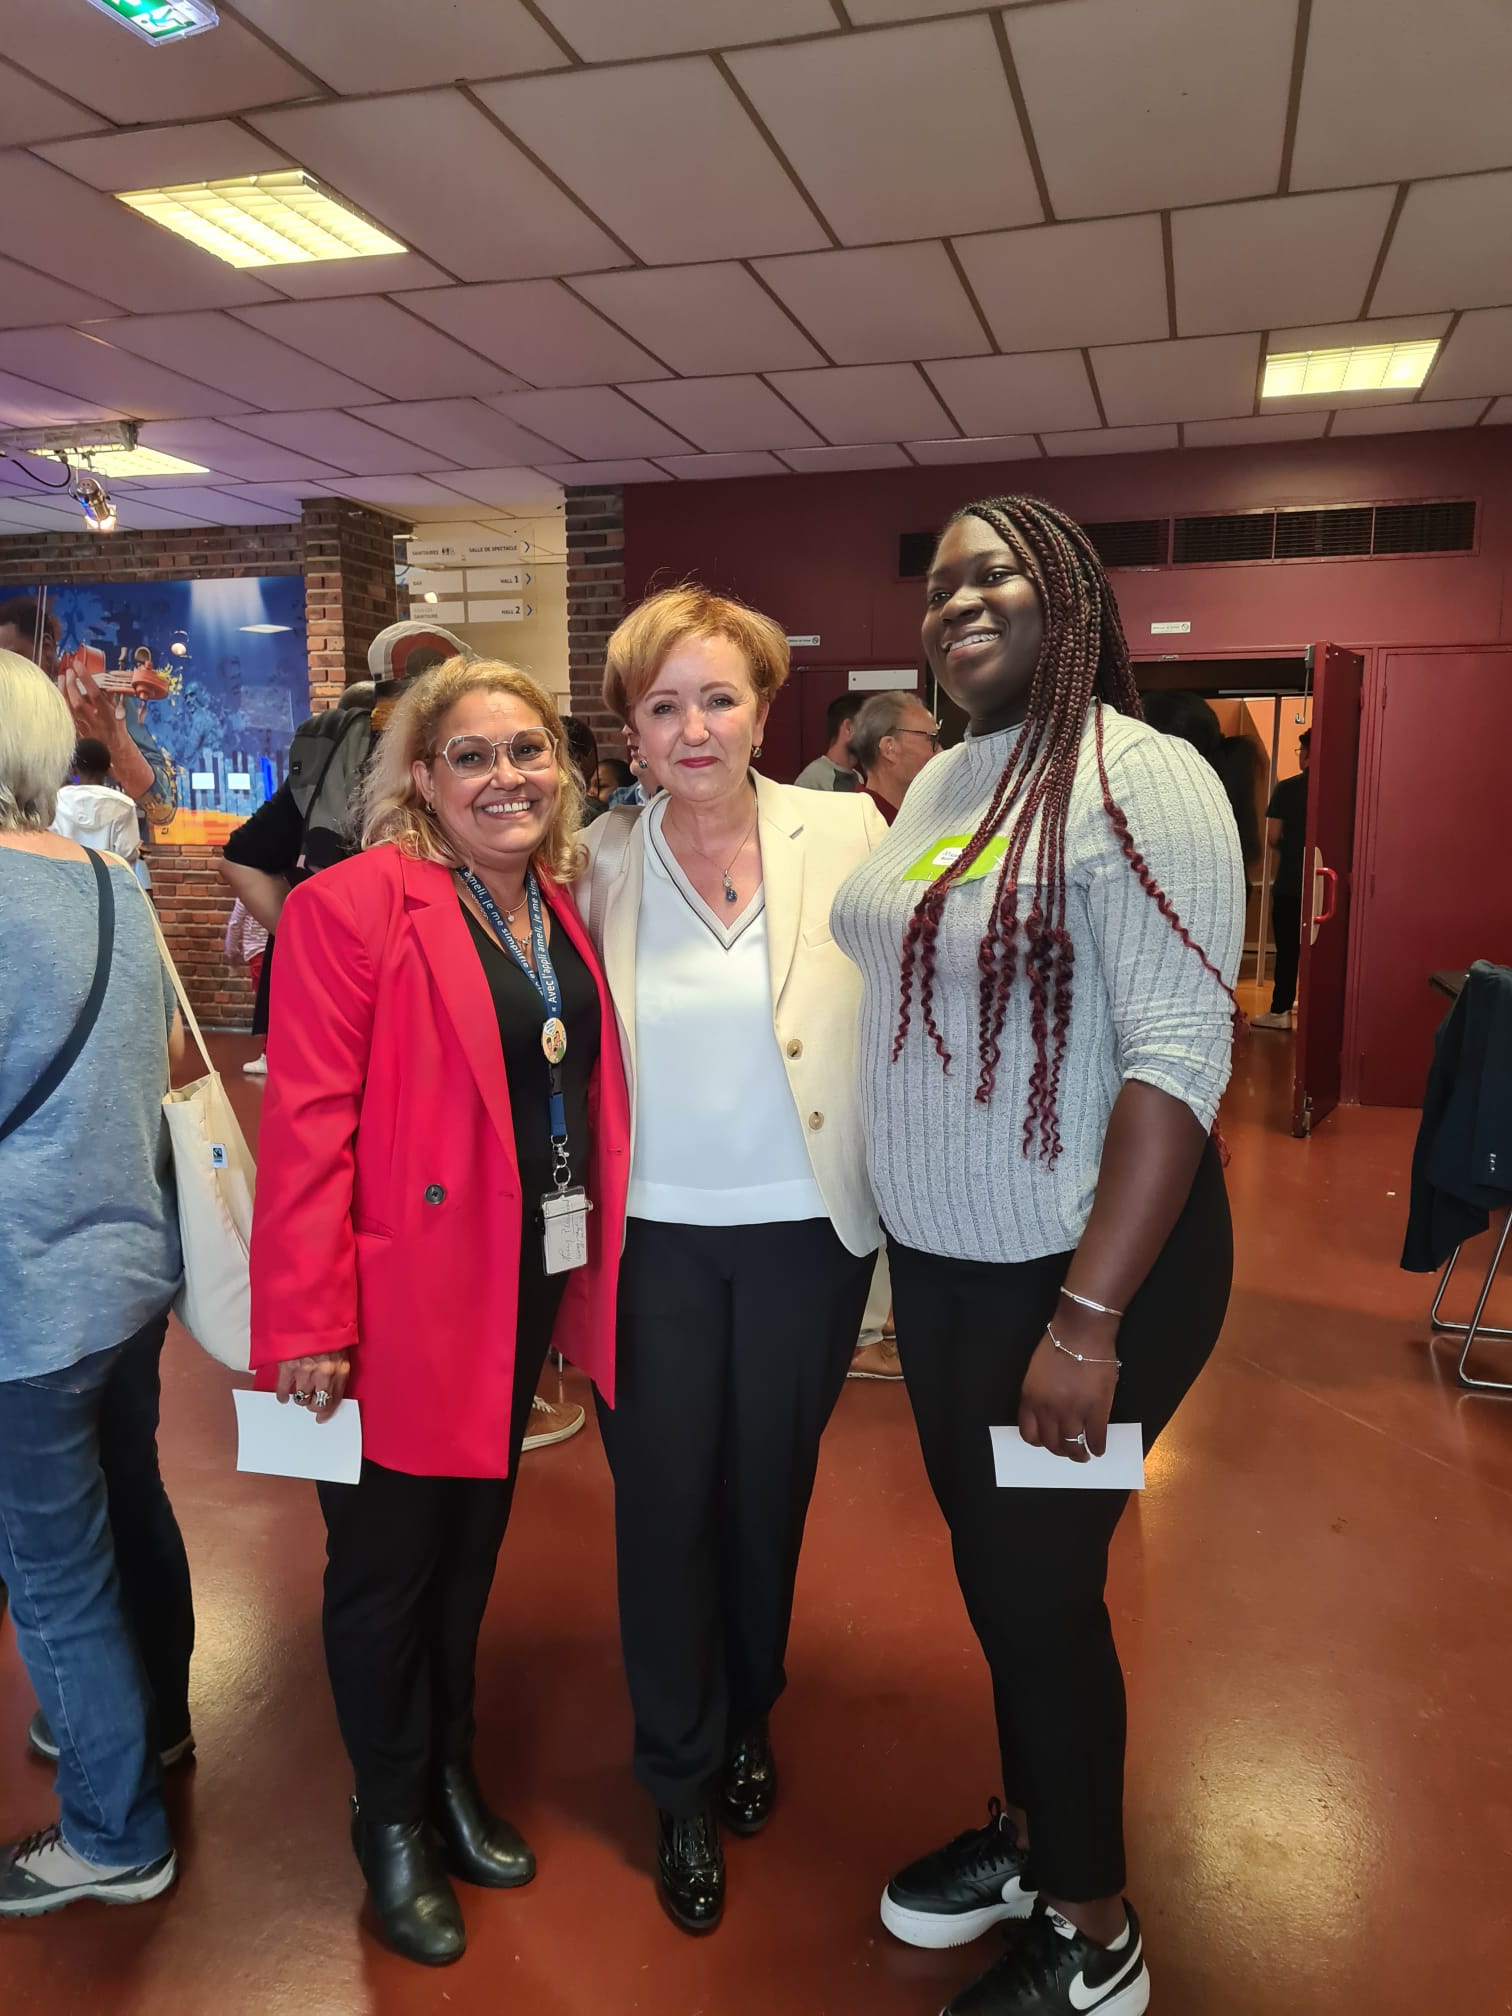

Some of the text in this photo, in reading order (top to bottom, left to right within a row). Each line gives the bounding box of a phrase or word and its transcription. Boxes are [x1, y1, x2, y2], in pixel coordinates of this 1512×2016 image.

[514, 575, 519, 583] 1
[515, 606, 521, 614] 2
[532, 899, 540, 912] me
[491, 911, 504, 926] me
[546, 980, 557, 1003] Avec
